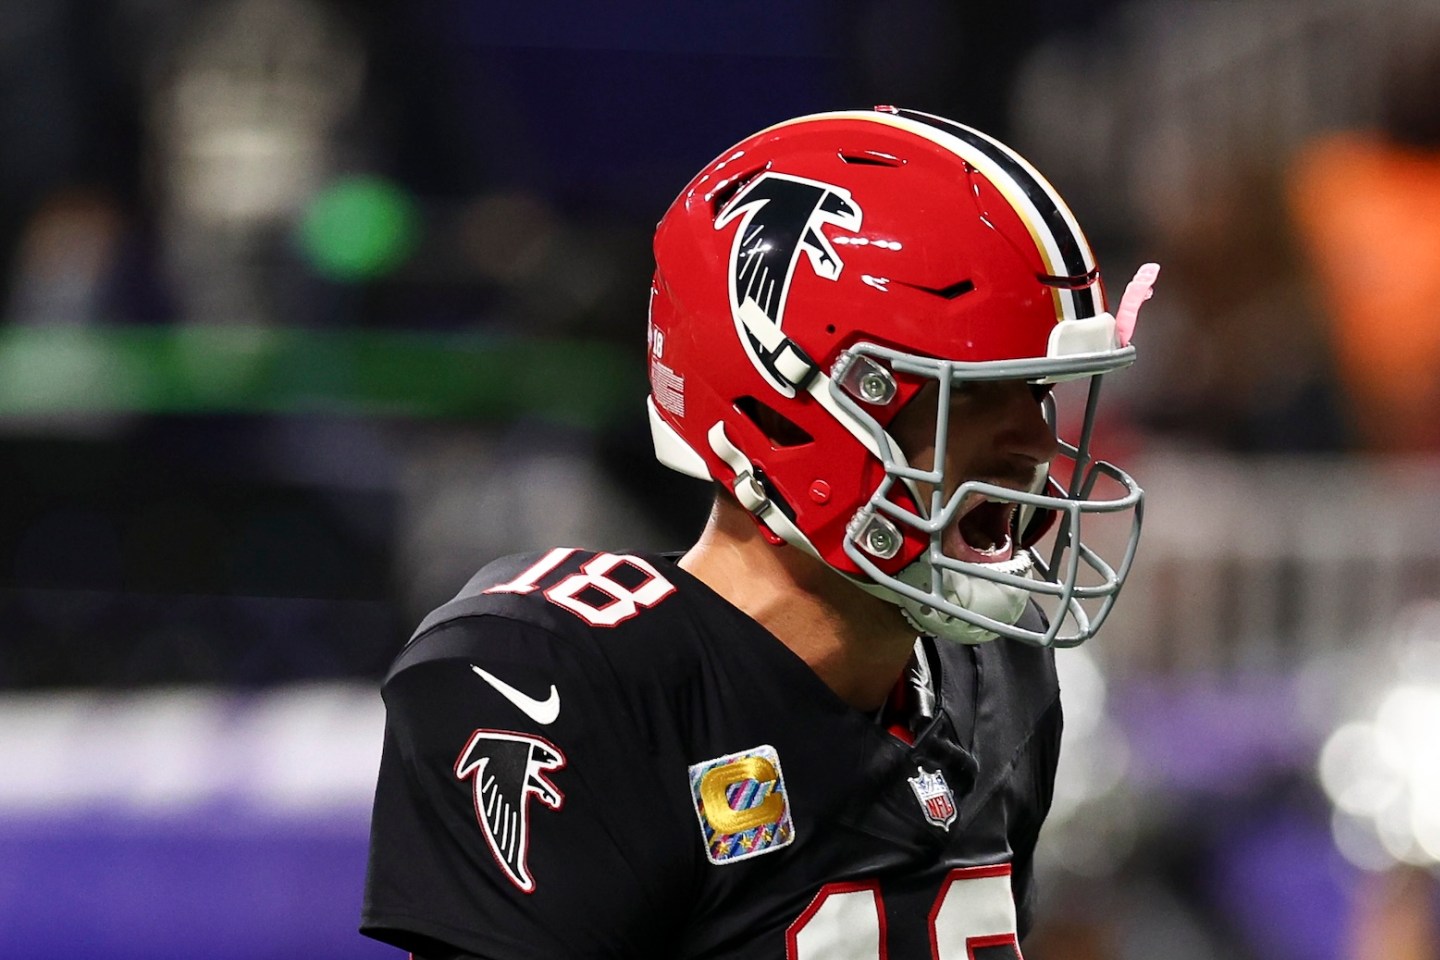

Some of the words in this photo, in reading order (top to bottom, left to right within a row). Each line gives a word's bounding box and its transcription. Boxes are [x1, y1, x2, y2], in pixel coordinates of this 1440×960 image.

[653, 329, 663, 358] 18
[482, 547, 677, 628] 18
[701, 756, 785, 835] C
